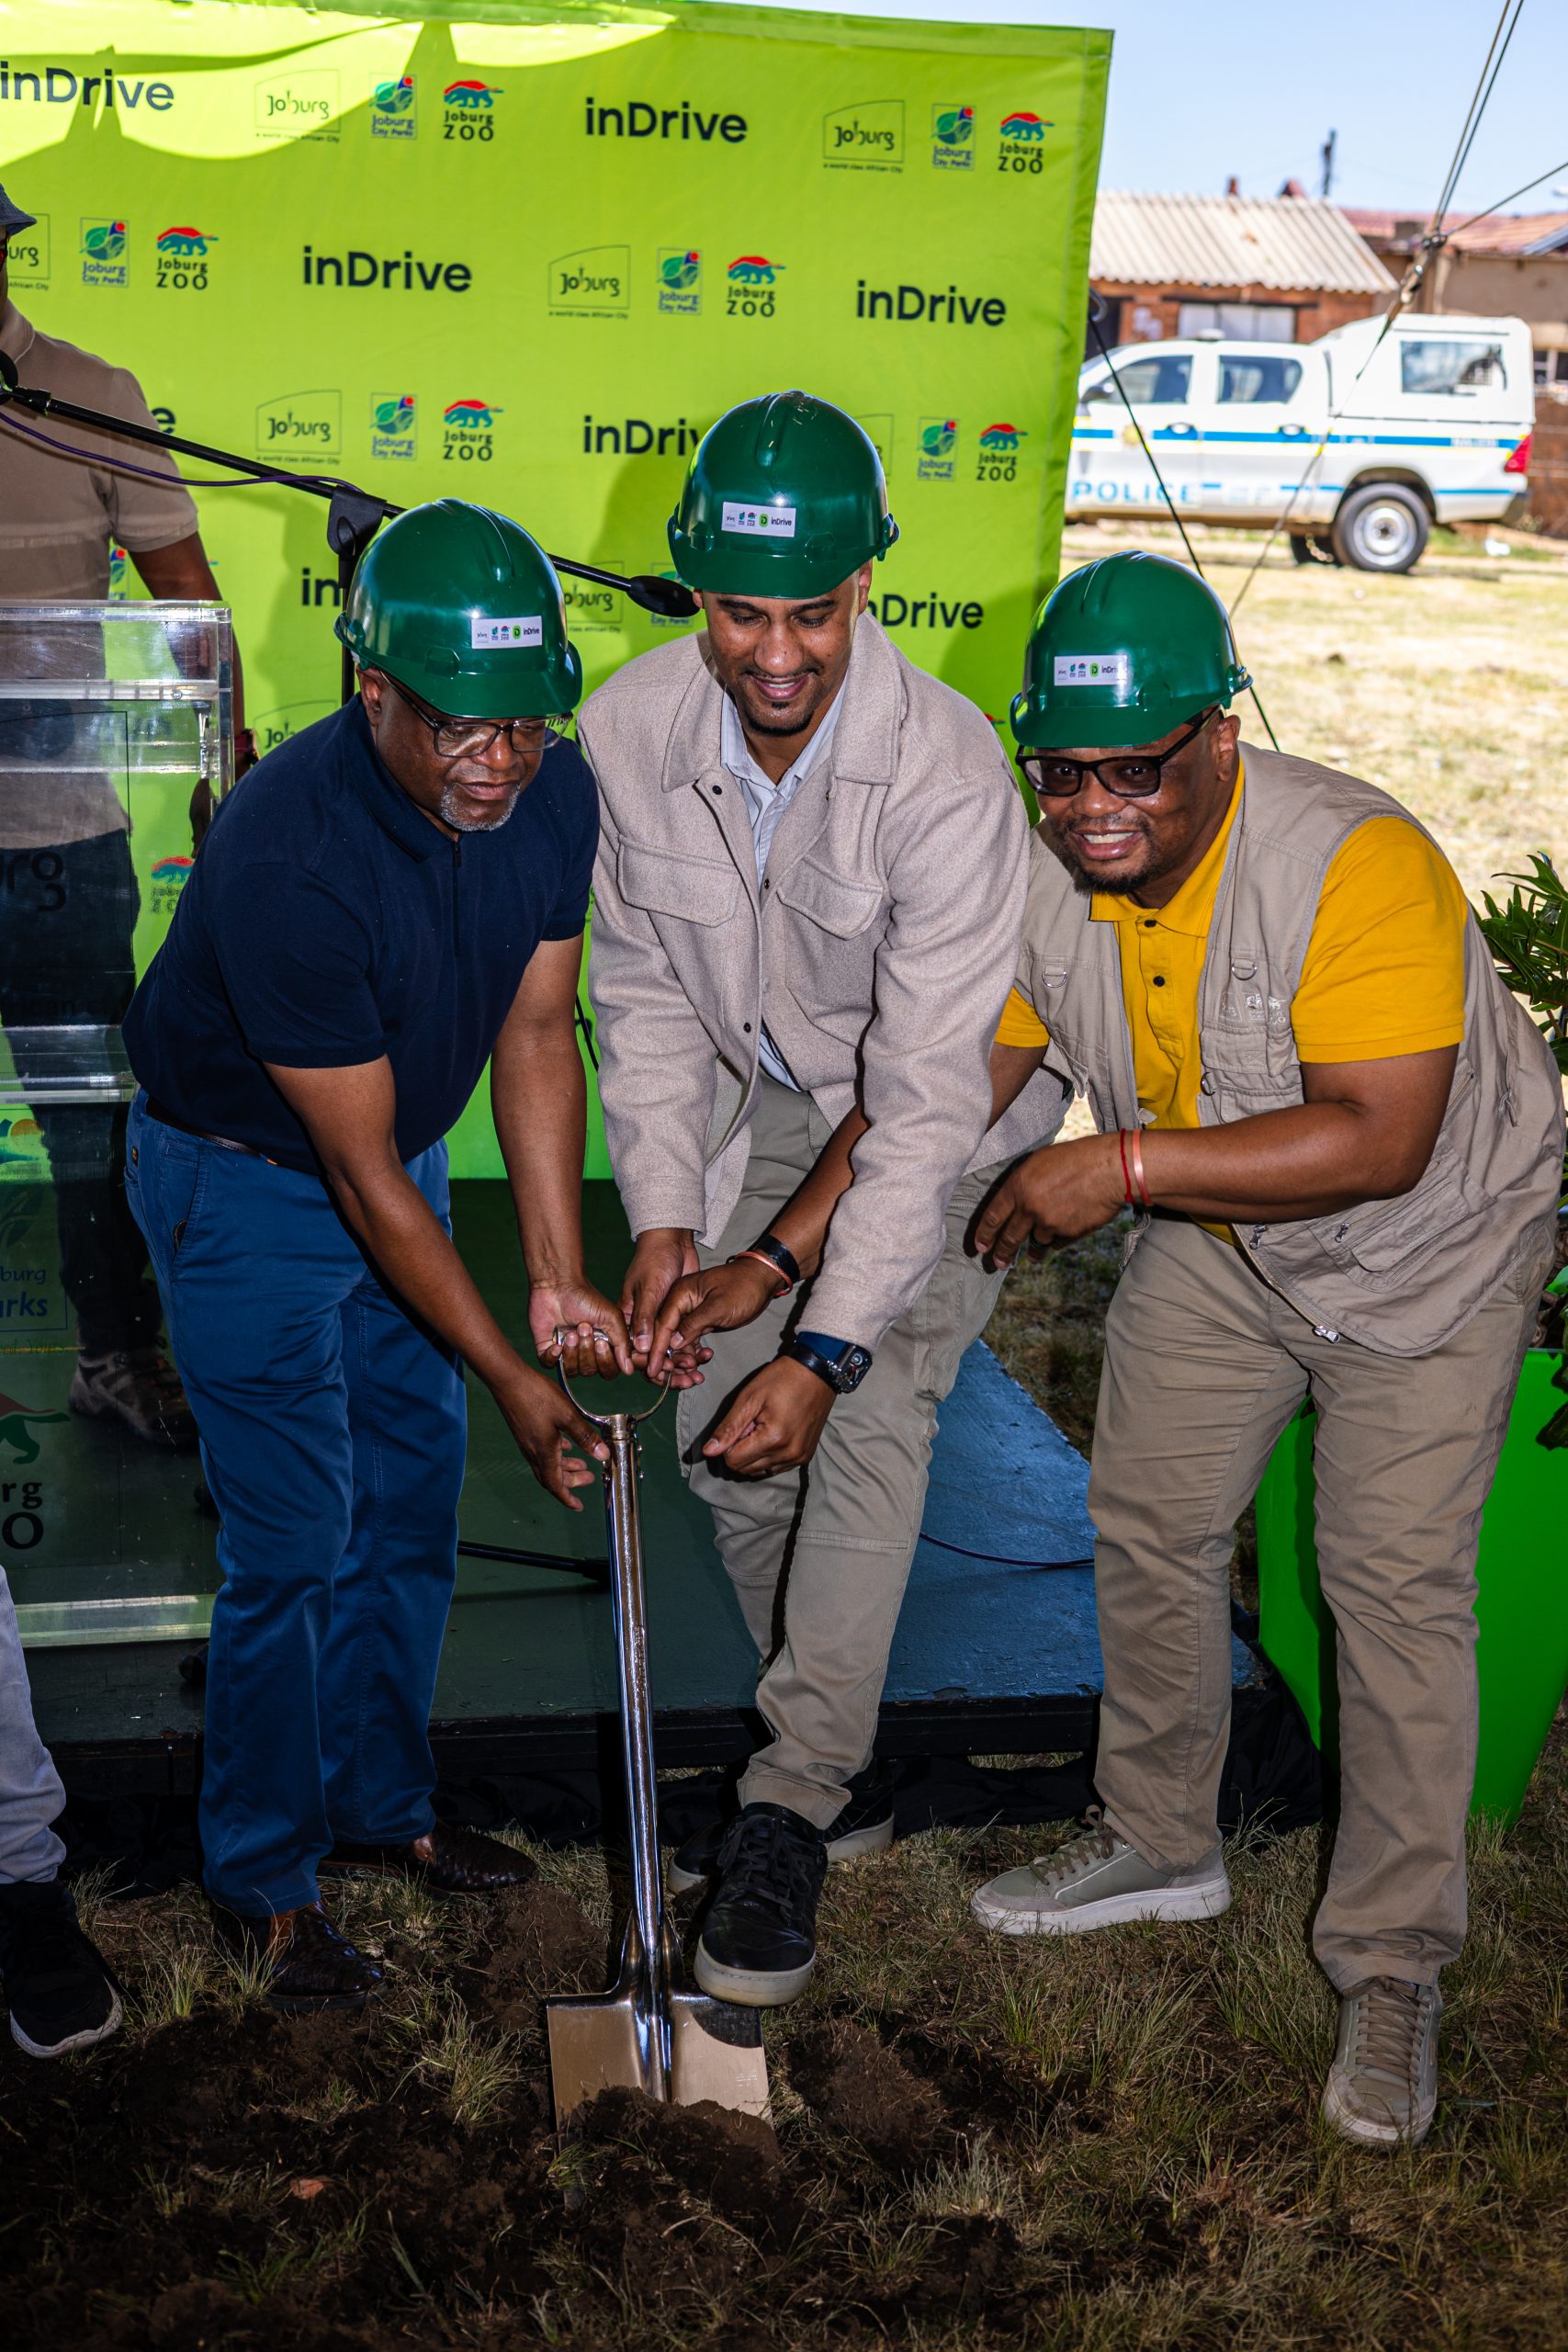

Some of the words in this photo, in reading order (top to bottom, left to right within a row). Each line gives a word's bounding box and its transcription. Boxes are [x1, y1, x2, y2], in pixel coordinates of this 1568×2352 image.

[0, 61, 174, 111] inDrive
[373, 115, 413, 129] Joburg
[445, 110, 493, 126] Joburg
[586, 97, 748, 143] inDrive
[444, 124, 494, 141] ZOO
[834, 120, 895, 152] Joburg
[933, 145, 971, 161] Joburg
[998, 142, 1043, 159] Joburg
[998, 155, 1043, 174] ZOO
[84, 261, 126, 278] Joburg
[158, 257, 208, 275] Joburg
[304, 245, 472, 292] inDrive
[157, 272, 208, 290] ZOO
[559, 266, 620, 298] Joburg
[659, 289, 698, 305] Joburg
[728, 286, 774, 302] Joburg
[856, 279, 1006, 326] inDrive
[727, 300, 774, 317] ZOO
[268, 411, 332, 443] Joburg
[373, 435, 413, 451] Joburg
[445, 430, 492, 447] Joburg
[443, 444, 492, 461] ZOO
[978, 452, 1017, 468] Joburg
[919, 458, 953, 471] Joburg
[976, 466, 1016, 481] ZOO
[1073, 481, 1199, 504] POLICE
[772, 516, 792, 526] inDrive
